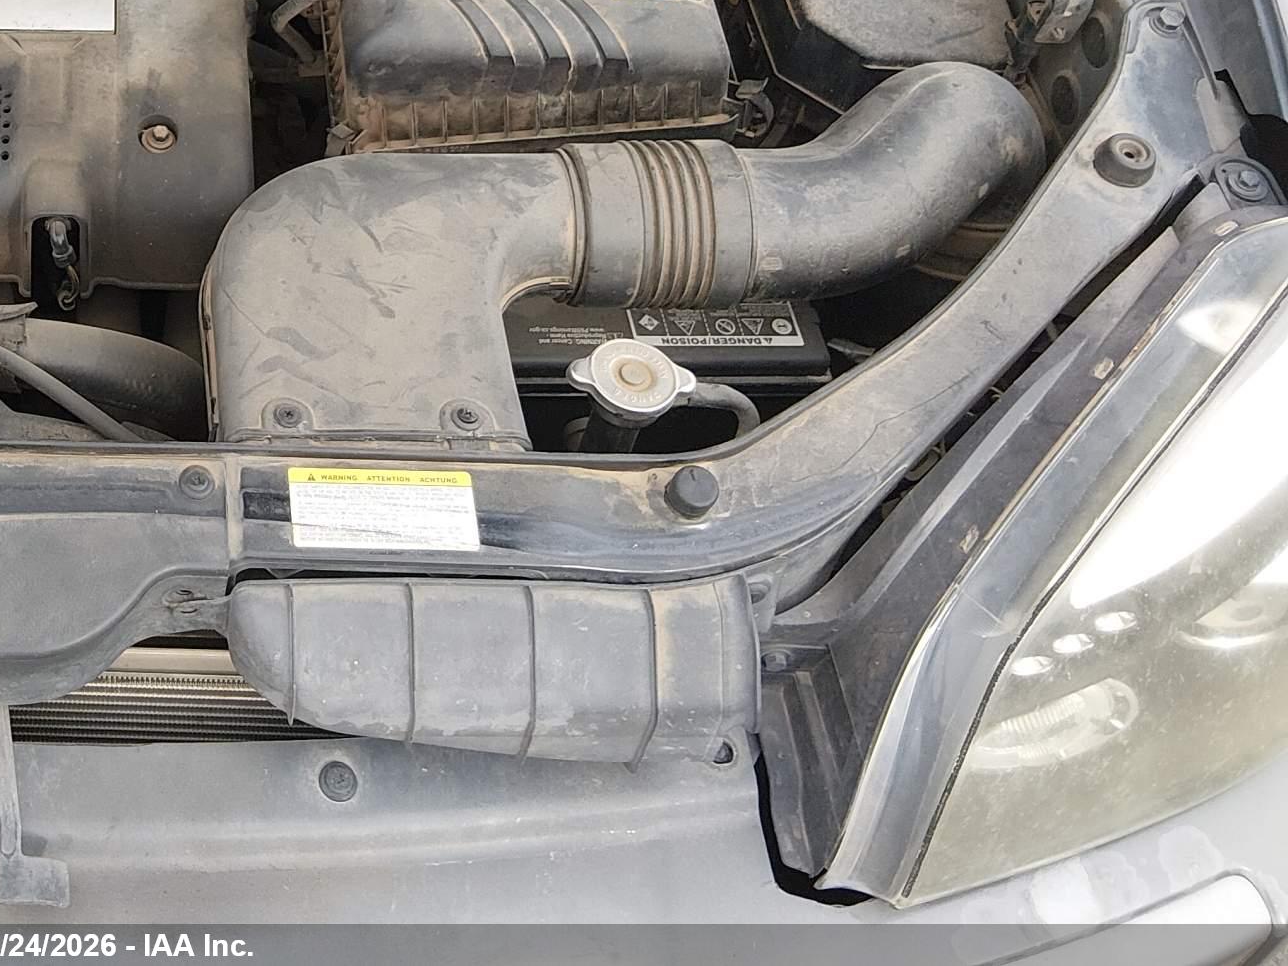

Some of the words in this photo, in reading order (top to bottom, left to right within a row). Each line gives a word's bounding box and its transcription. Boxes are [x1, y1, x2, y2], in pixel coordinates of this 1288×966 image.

[660, 337, 762, 346] DANGER/POISON
[320, 474, 358, 482] WARNING
[367, 475, 411, 483] ATTENTION
[420, 476, 458, 484] ACHTUNG
